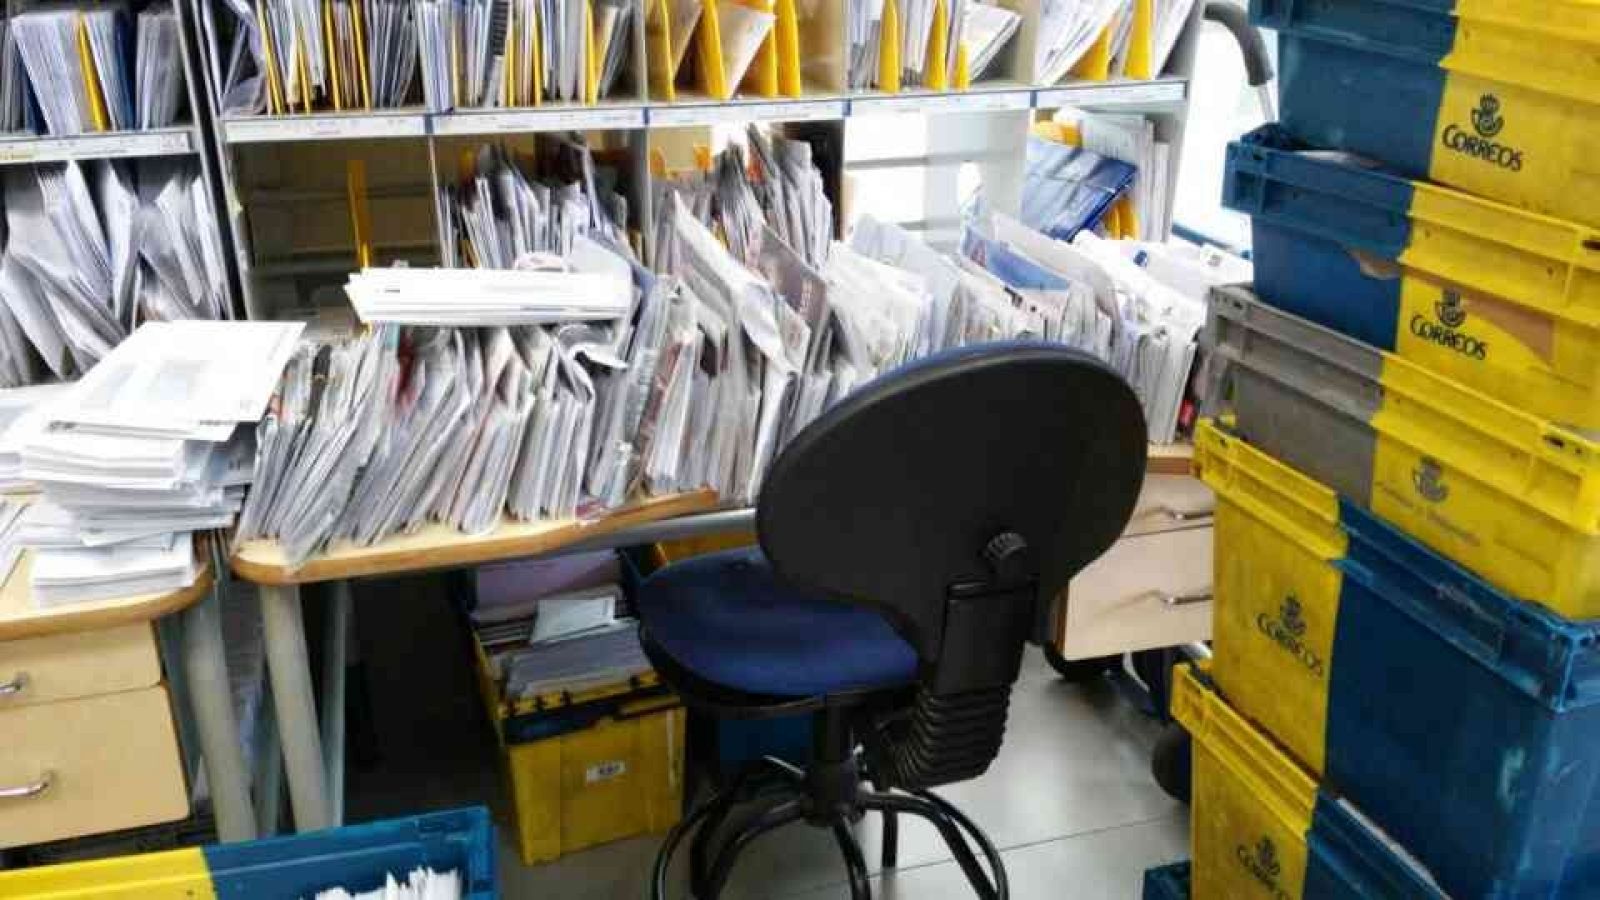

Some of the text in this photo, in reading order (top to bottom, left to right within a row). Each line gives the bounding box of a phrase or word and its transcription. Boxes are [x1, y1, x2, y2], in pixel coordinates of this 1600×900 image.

[1442, 123, 1523, 171] CORREOS
[1410, 314, 1488, 361] CORREOS
[1257, 612, 1323, 677] CORREOS
